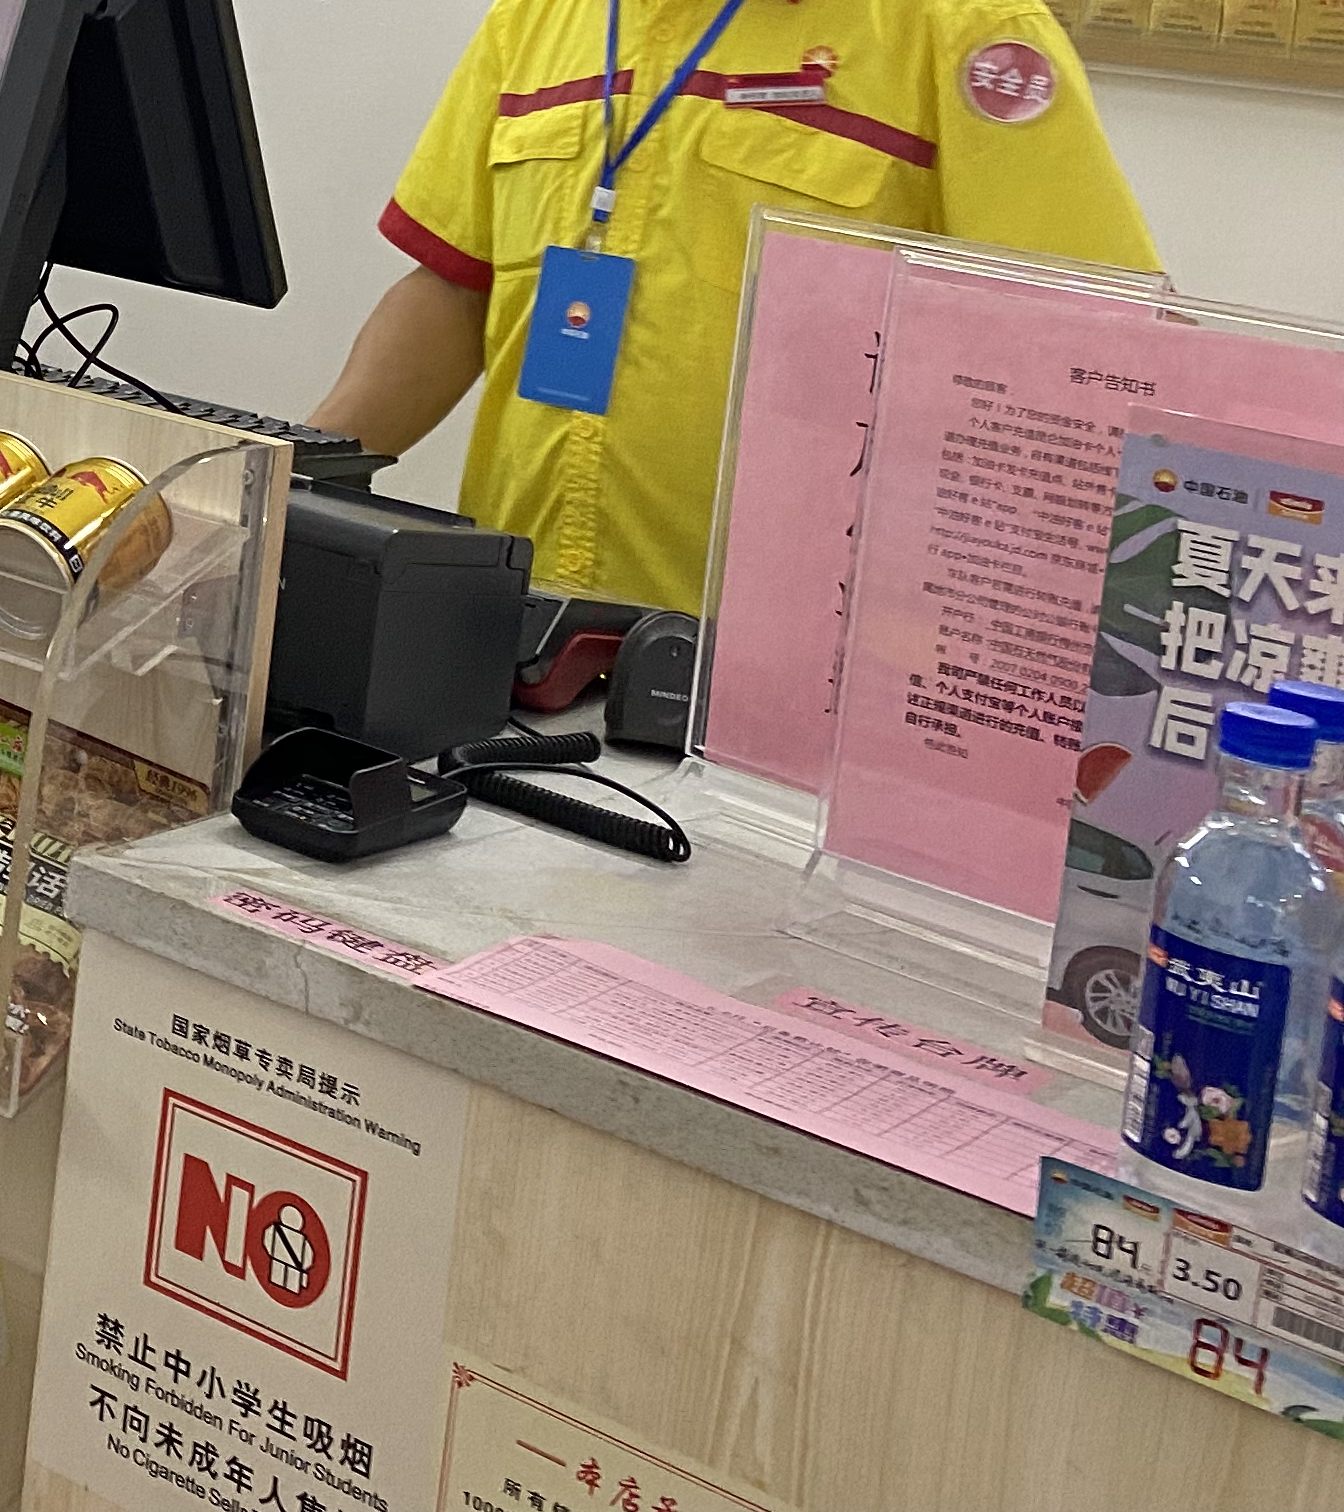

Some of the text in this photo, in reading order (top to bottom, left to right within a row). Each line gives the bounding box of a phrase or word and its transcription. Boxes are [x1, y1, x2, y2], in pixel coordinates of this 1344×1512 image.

[970, 59, 1053, 103] 安全员
[1069, 367, 1157, 397] 客户告知书
[1182, 478, 1249, 505] 中国石油
[1149, 685, 1216, 761] 后
[223, 891, 438, 976] 密码键盘
[1166, 958, 1261, 1000] 武夷山
[170, 1012, 363, 1107] 国家烟草专卖局提示
[792, 995, 1029, 1081] 宣传台牌
[112, 1017, 422, 1157] State Tobacco Monopoly Administration Warning
[174, 1151, 332, 1310] NO
[1172, 1257, 1244, 1302] 3.50
[74, 1341, 391, 1512] Smoking Forbidden For Junior Students
[94, 1312, 375, 1481] 禁止中小学生吸烟
[106, 1432, 131, 1460] No
[131, 1447, 207, 1500] Cigarette
